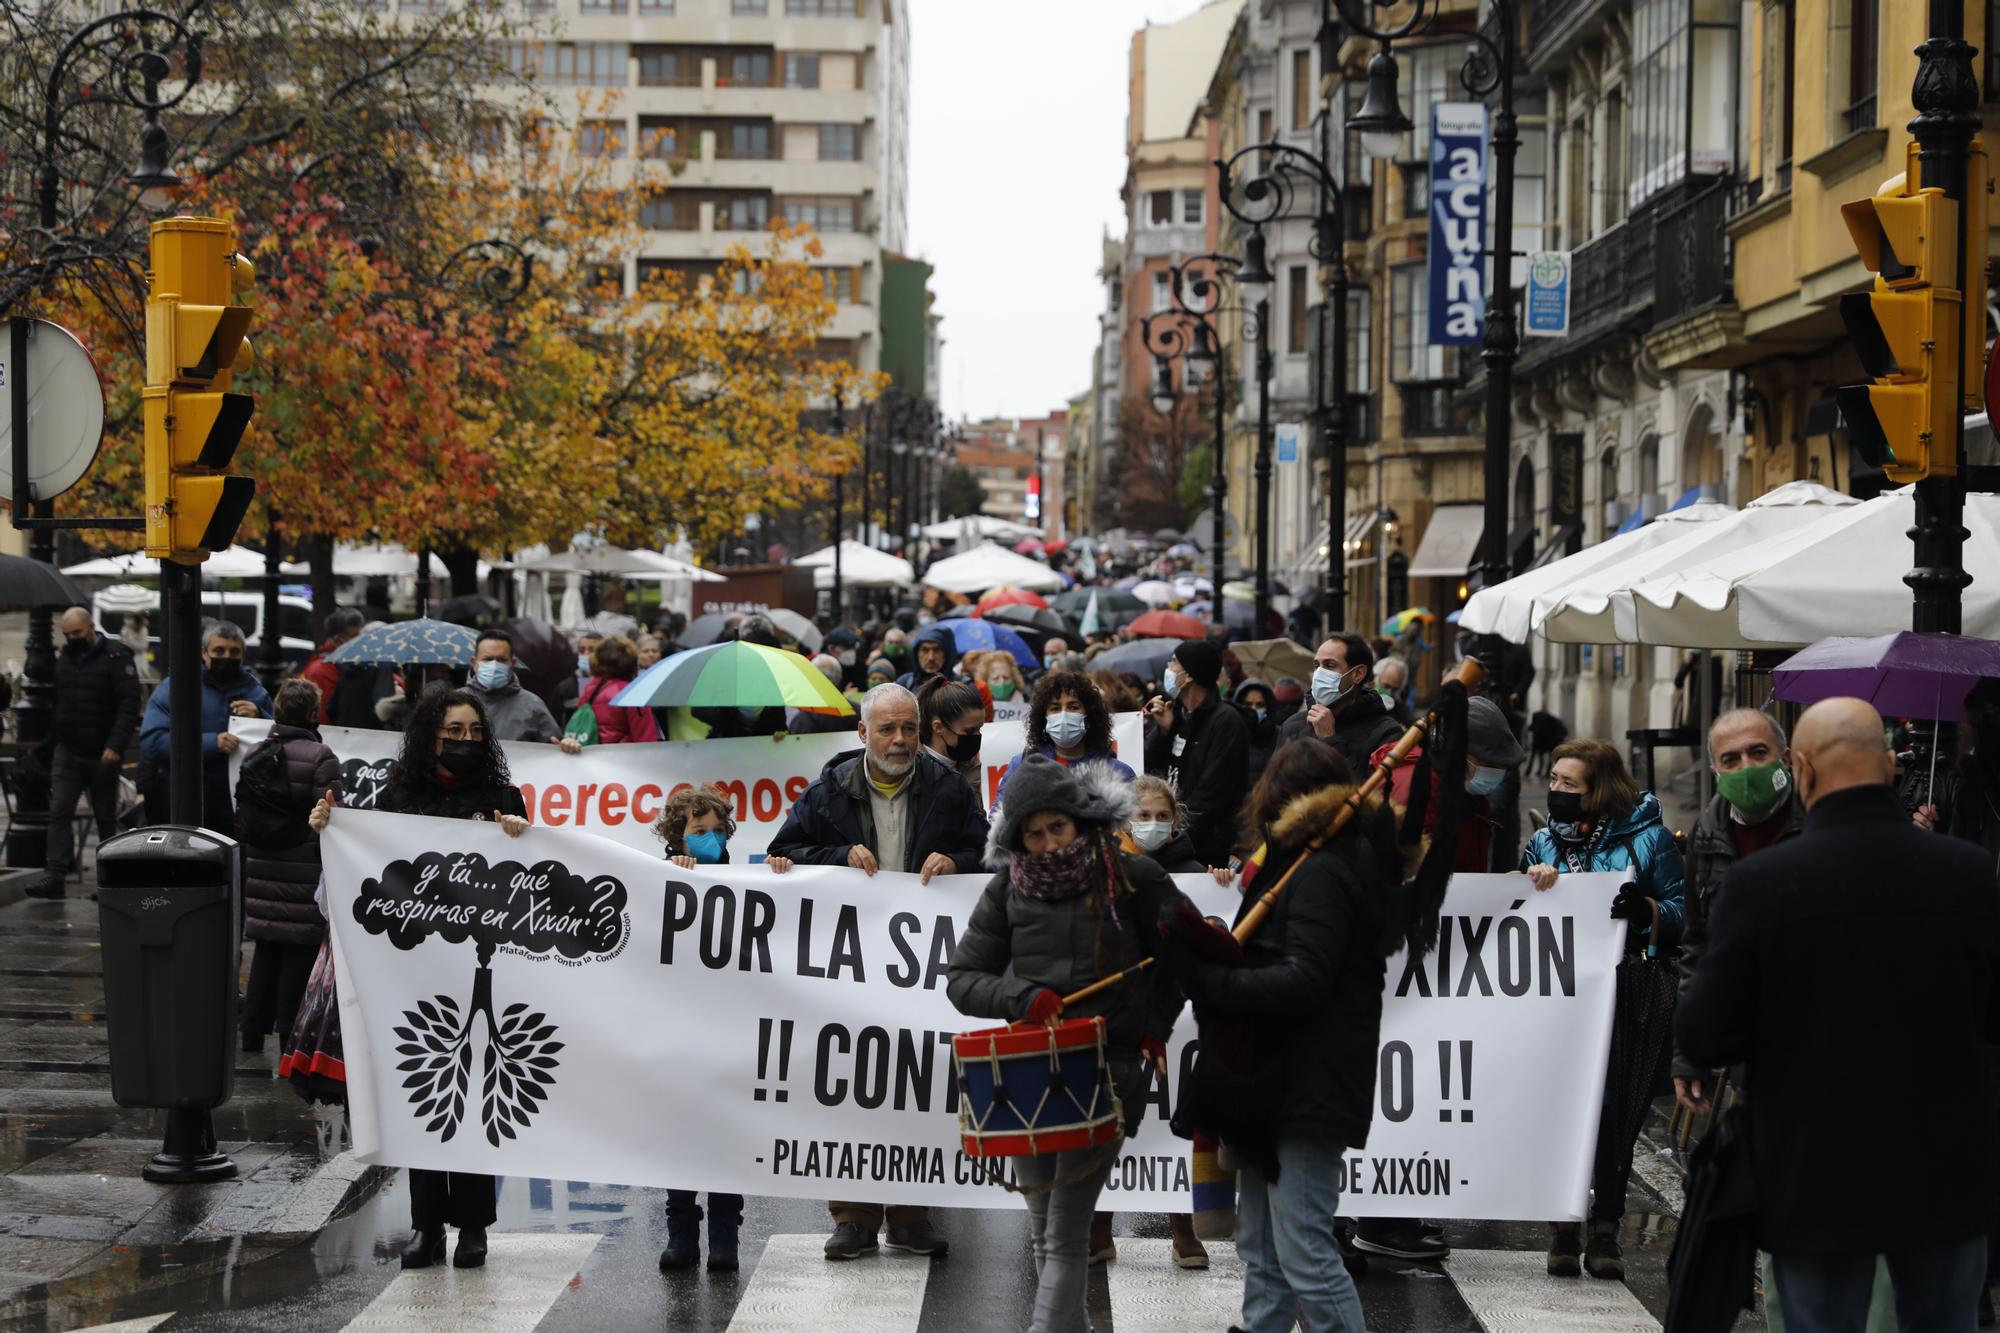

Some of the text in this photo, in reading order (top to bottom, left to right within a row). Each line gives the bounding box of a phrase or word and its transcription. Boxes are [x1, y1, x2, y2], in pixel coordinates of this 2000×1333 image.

[993, 709, 1015, 720] TOP
[355, 761, 389, 789] qué
[413, 861, 440, 895] y
[508, 863, 555, 905] qué
[365, 894, 478, 934] respiras
[480, 903, 507, 930] en
[660, 880, 776, 974] POR
[796, 897, 866, 984] LA
[886, 911, 956, 991] SA
[499, 912, 632, 968] Plataforma contra la Contaminación
[753, 1017, 795, 1103] !!
[813, 1021, 960, 1115] CONT
[1437, 1039, 1474, 1124] !!
[773, 1138, 946, 1185] PLATAFORMA
[1105, 1154, 1191, 1194] CONTA
[1371, 1151, 1451, 1197] XIXÓN
